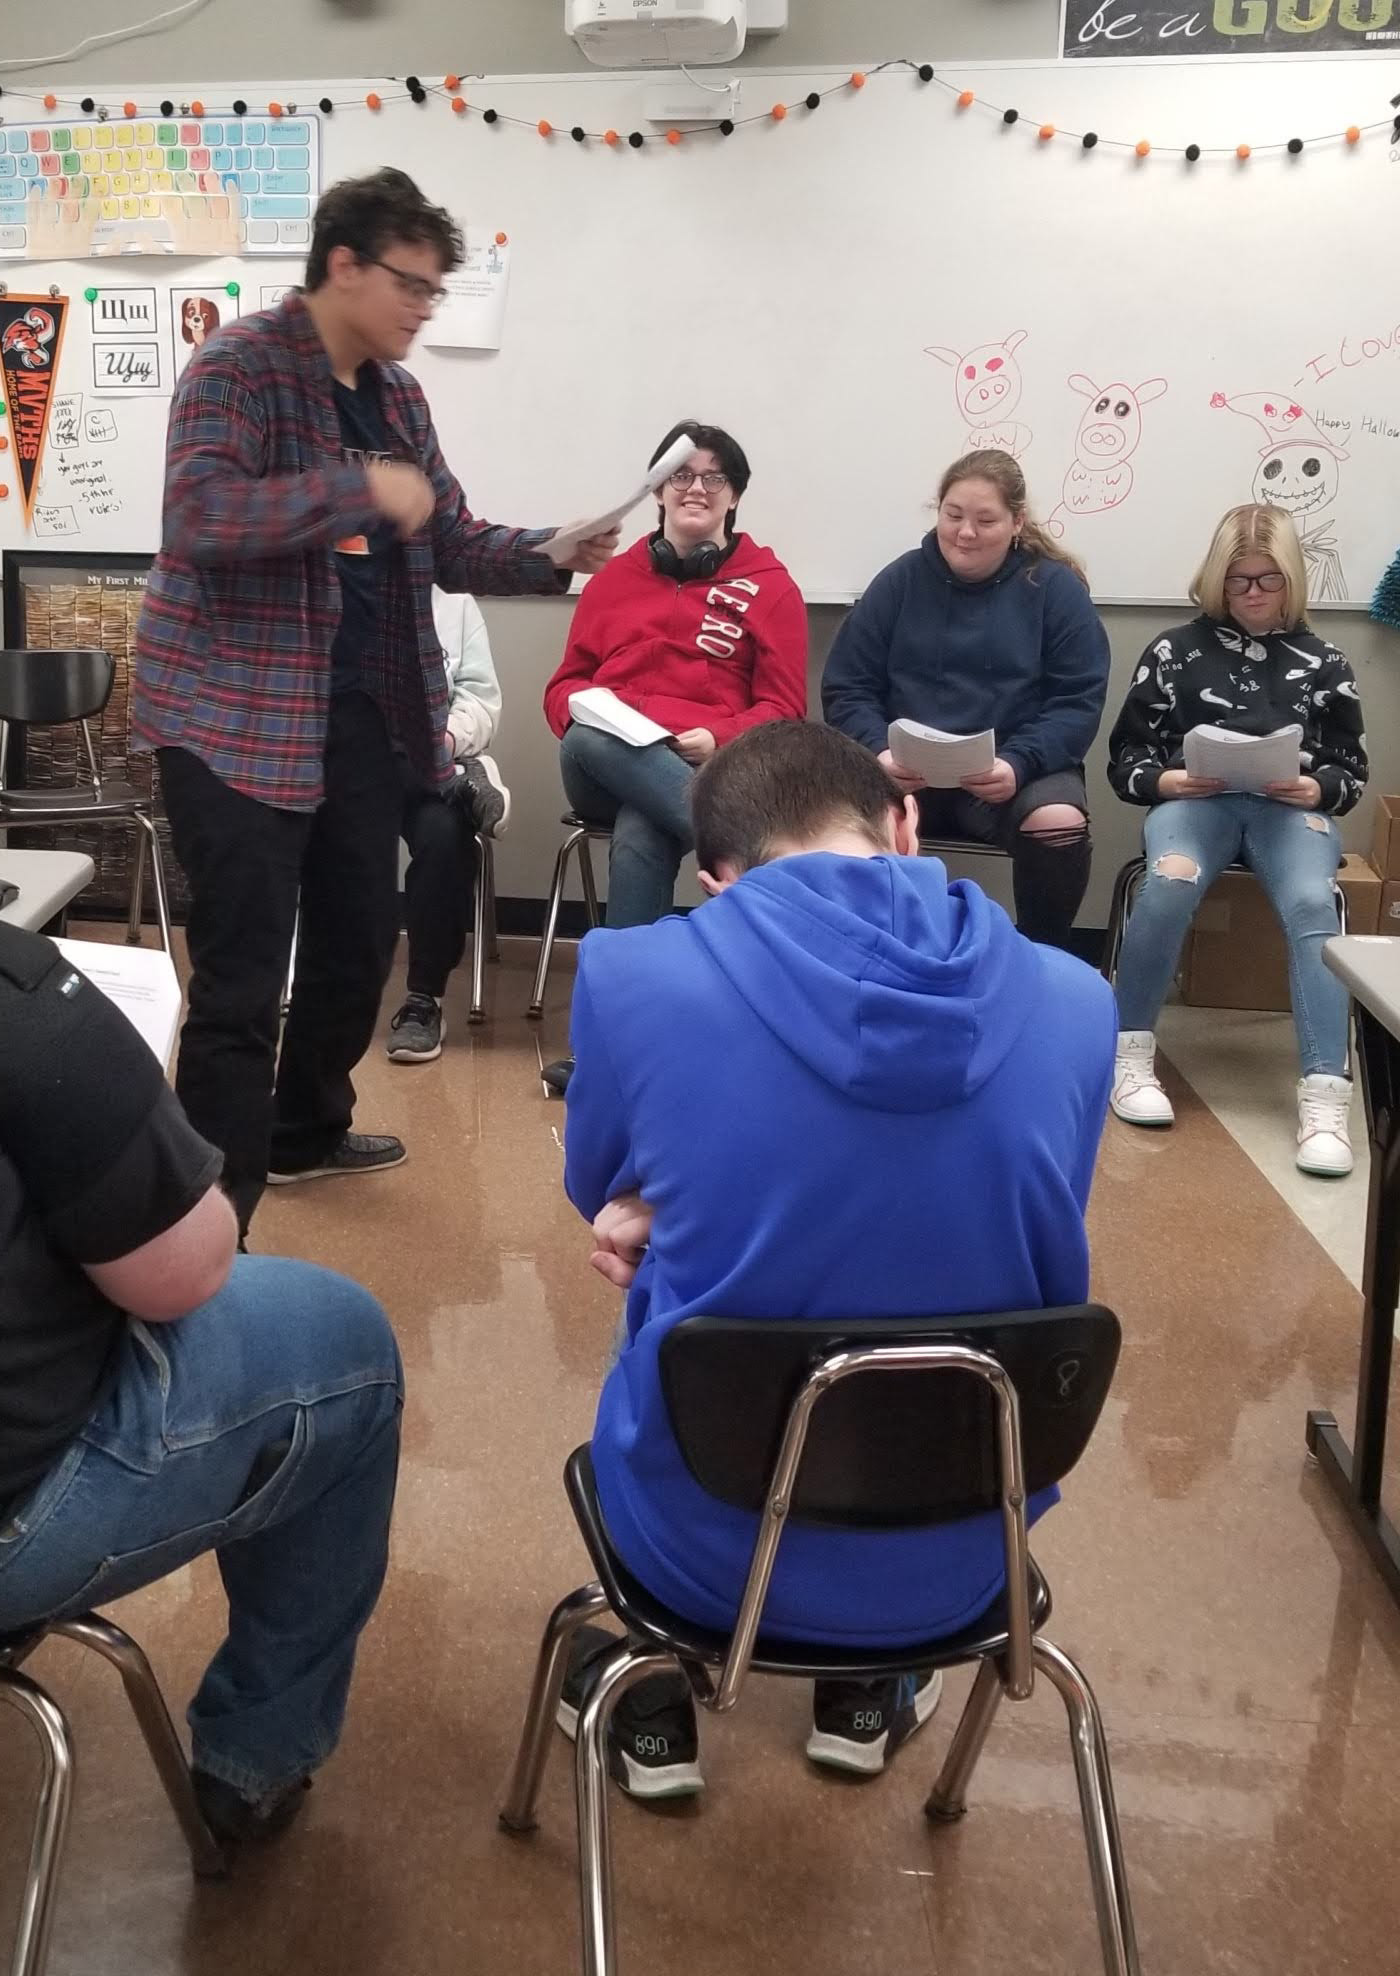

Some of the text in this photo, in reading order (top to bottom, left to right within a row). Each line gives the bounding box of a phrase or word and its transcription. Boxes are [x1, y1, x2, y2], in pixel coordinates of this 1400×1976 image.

[632, 0, 658, 8] EPSON
[1159, 12, 1207, 38] a
[6, 370, 18, 398] HOME
[11, 398, 19, 412] OF
[16, 370, 51, 459] MVTHS
[1315, 408, 1351, 430] Happy
[853, 1711, 882, 1731] 890
[635, 1734, 669, 1756] 890
